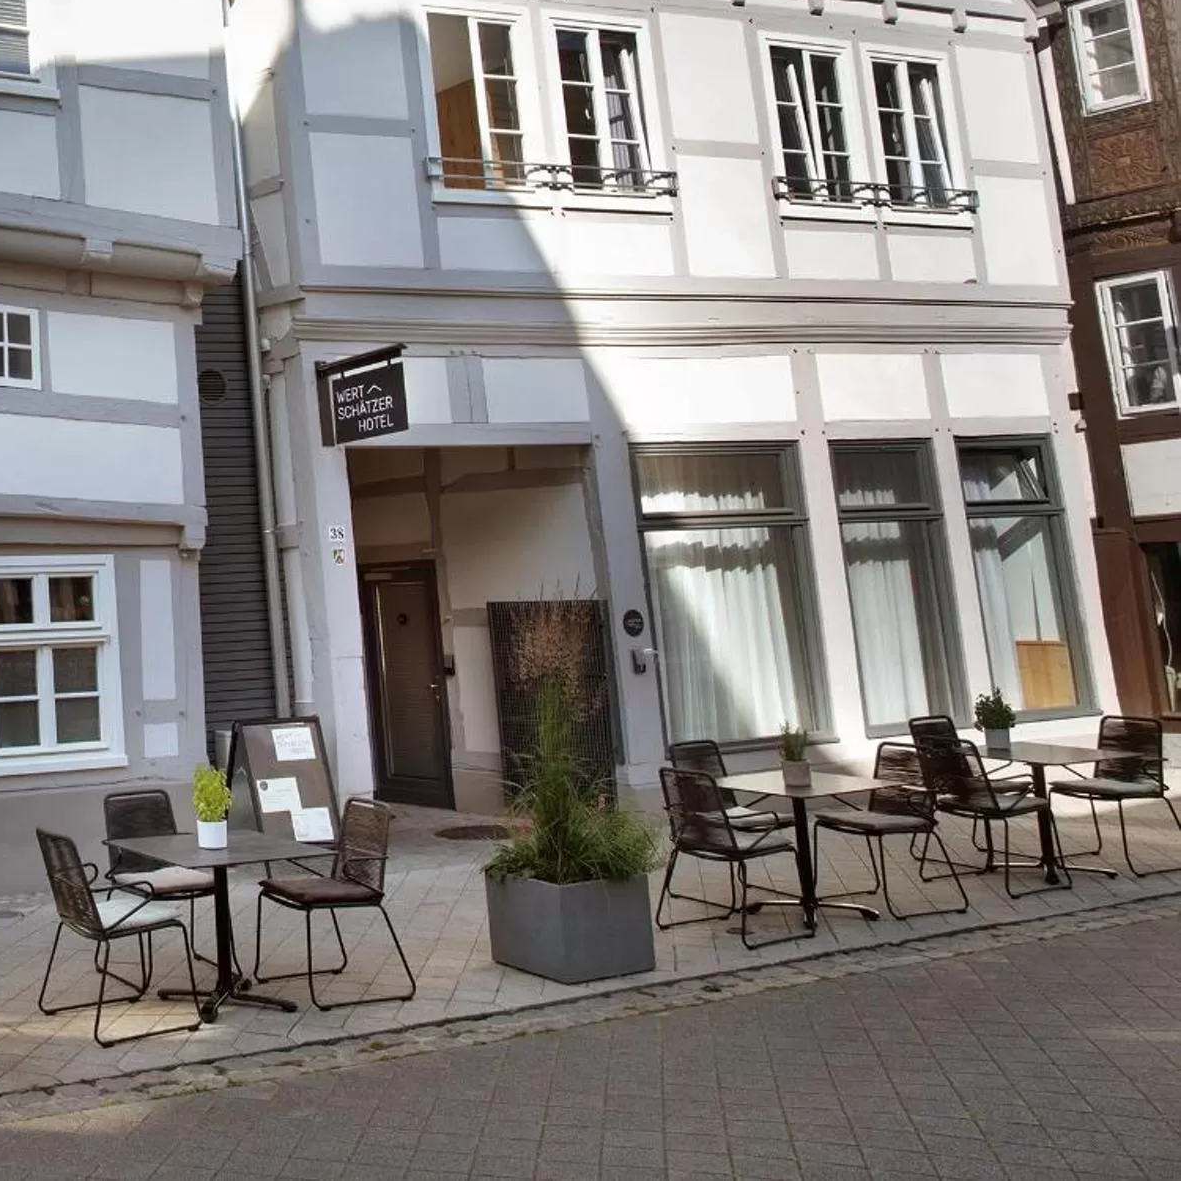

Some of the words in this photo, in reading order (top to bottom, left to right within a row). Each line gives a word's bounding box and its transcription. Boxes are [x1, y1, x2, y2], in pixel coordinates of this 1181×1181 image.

[336, 385, 365, 403] WERT
[358, 414, 395, 432] HOTEL
[330, 527, 344, 540] 38
